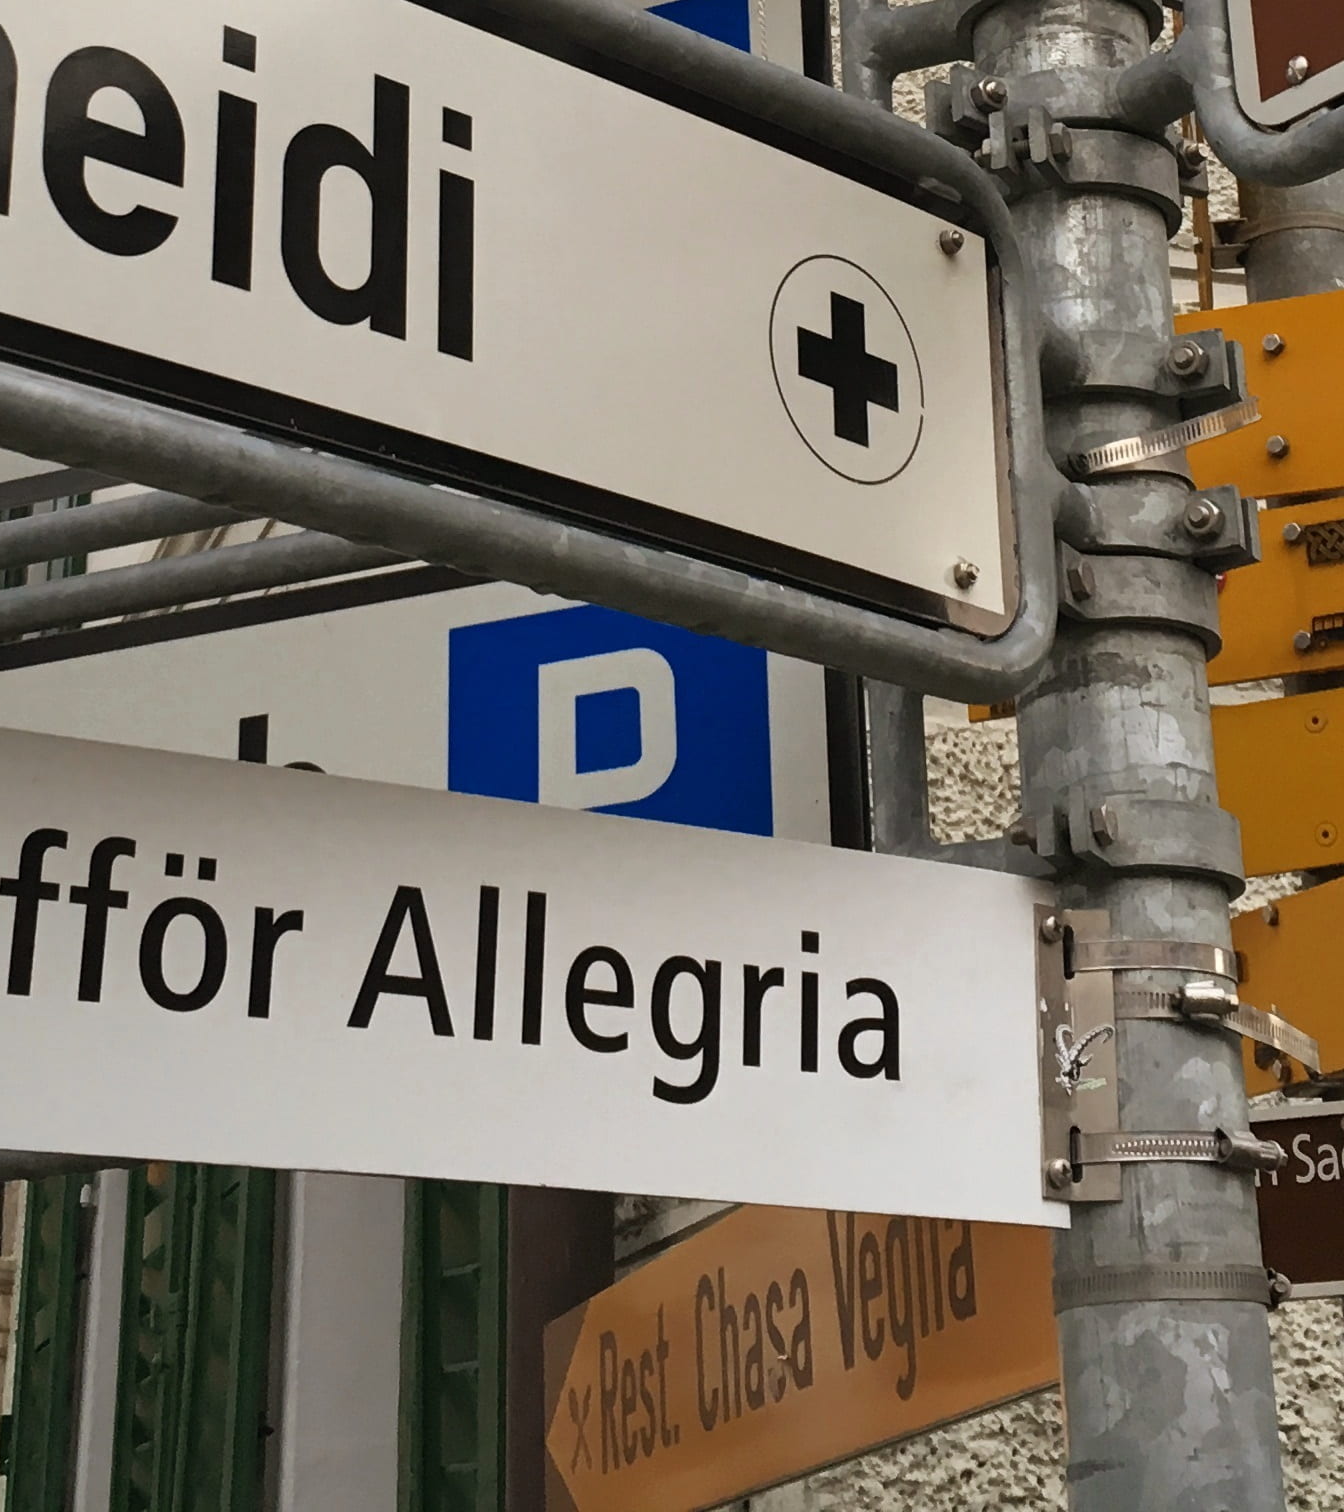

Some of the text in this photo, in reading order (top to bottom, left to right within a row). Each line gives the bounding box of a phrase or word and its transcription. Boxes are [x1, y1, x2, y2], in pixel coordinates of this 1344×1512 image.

[348, 885, 902, 1106] Allegria
[600, 1303, 680, 1474] Rest.
[695, 1267, 814, 1432] Chasa
